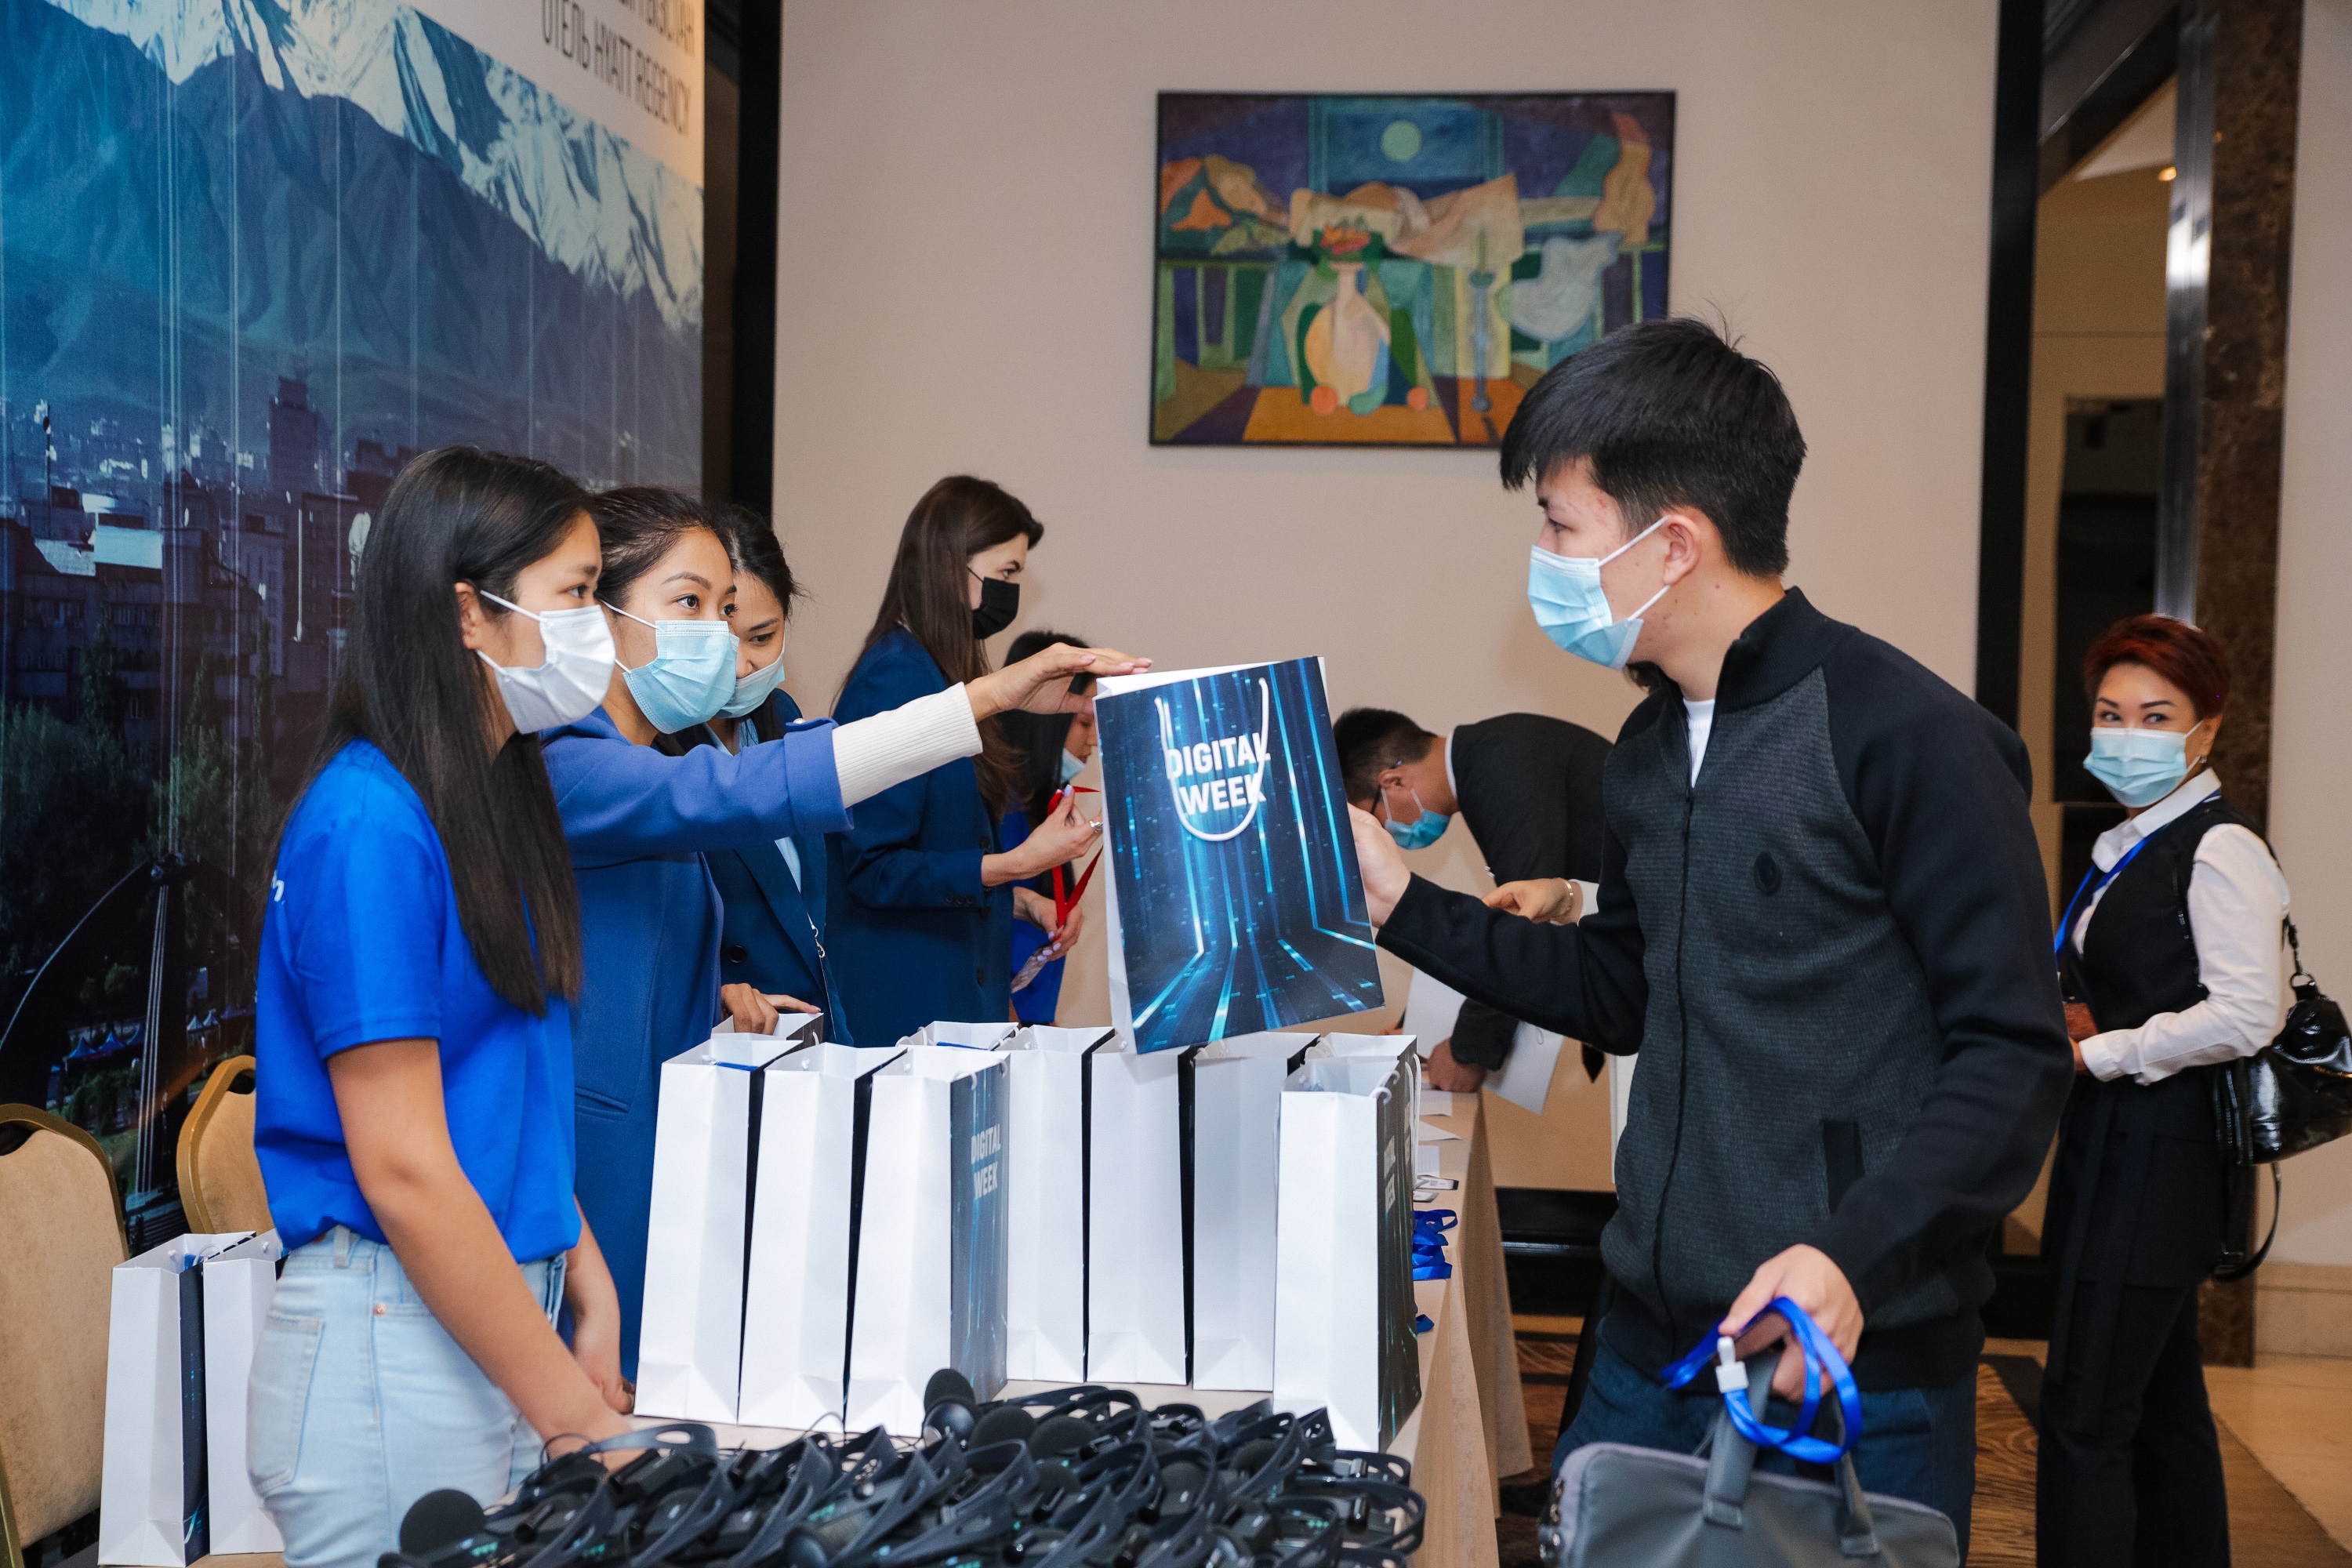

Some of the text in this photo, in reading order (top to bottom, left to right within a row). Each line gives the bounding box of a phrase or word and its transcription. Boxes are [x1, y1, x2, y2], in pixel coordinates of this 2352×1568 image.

[542, 0, 691, 136] ОТЕЛЬ HYATT REGENCY
[1167, 731, 1271, 779] DIGITAL
[1178, 772, 1267, 816] WEEK
[971, 1123, 1000, 1164] DIGITAL
[974, 1161, 998, 1200] WEEK
